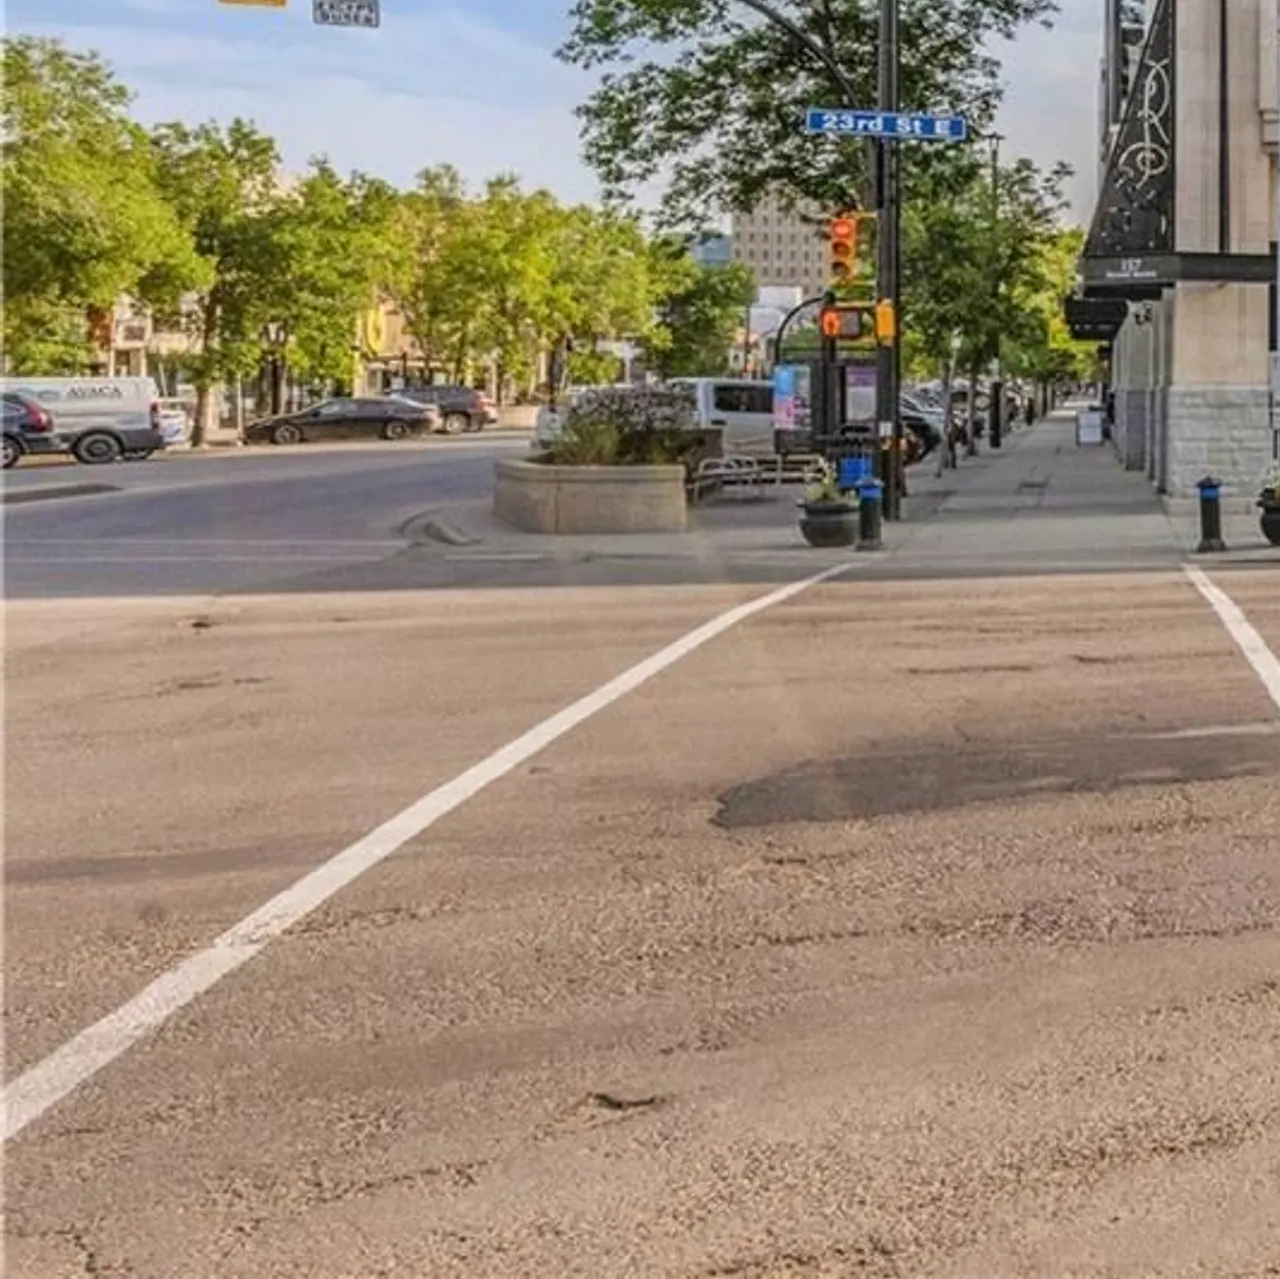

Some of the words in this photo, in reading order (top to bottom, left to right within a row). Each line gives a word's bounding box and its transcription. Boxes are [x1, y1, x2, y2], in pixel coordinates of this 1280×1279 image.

[821, 113, 884, 133] 23rd
[895, 117, 923, 134] St
[934, 119, 951, 135] E
